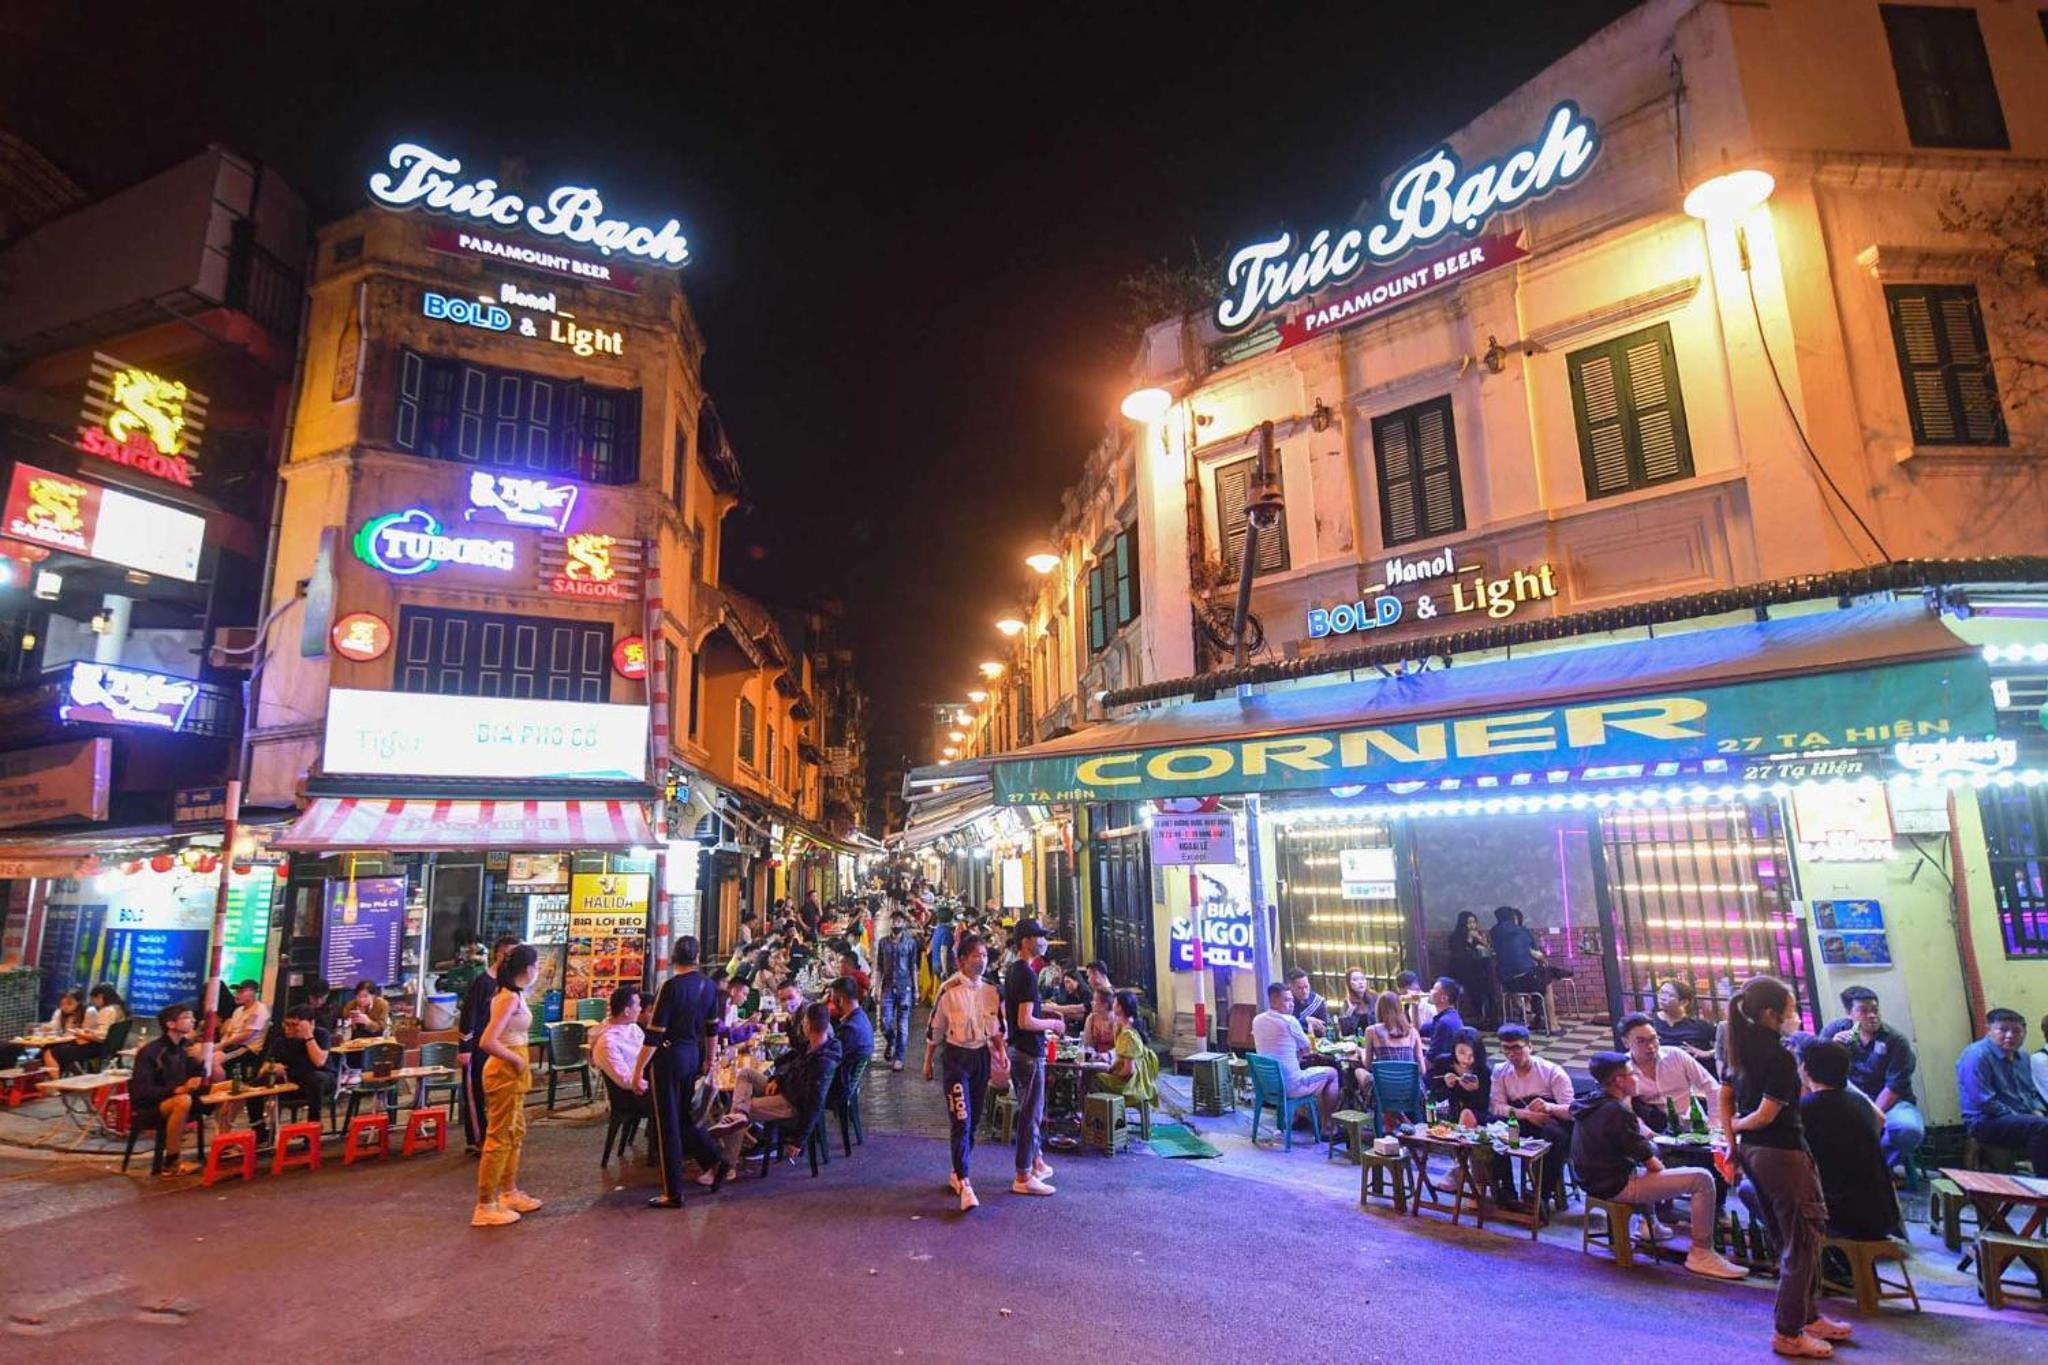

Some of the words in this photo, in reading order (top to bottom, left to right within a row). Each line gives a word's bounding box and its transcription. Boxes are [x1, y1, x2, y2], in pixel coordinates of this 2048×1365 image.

[370, 143, 523, 224] Trúc
[526, 186, 689, 263] Bạch
[1218, 230, 1361, 327] Trúc
[1368, 106, 1592, 254] Bạch
[459, 235, 569, 271] PARAMOUNT
[572, 257, 611, 280] BEER
[1305, 270, 1429, 331] PARAMOUNT
[1433, 246, 1486, 281] BEER
[423, 292, 512, 331] BOLD
[519, 317, 537, 337] &
[550, 319, 624, 357] Light
[82, 426, 191, 486] SAIGON
[382, 528, 514, 570] TUBORG
[553, 578, 620, 597] SAIGON
[1308, 595, 1402, 638] BOLD
[1417, 595, 1438, 620] &
[1452, 563, 1558, 619] Light
[1076, 698, 1708, 787] CORNER
[1718, 737, 1763, 754] 27
[1776, 731, 1830, 749] TẠ
[1743, 765, 1773, 780] 27
[1778, 763, 1806, 780] Tạ
[1810, 760, 1863, 777] Hiện
[1008, 793, 1024, 802] 27
[573, 917, 592, 926] BIA
[583, 896, 633, 908] HALIDA
[1207, 902, 1235, 918] BIA
